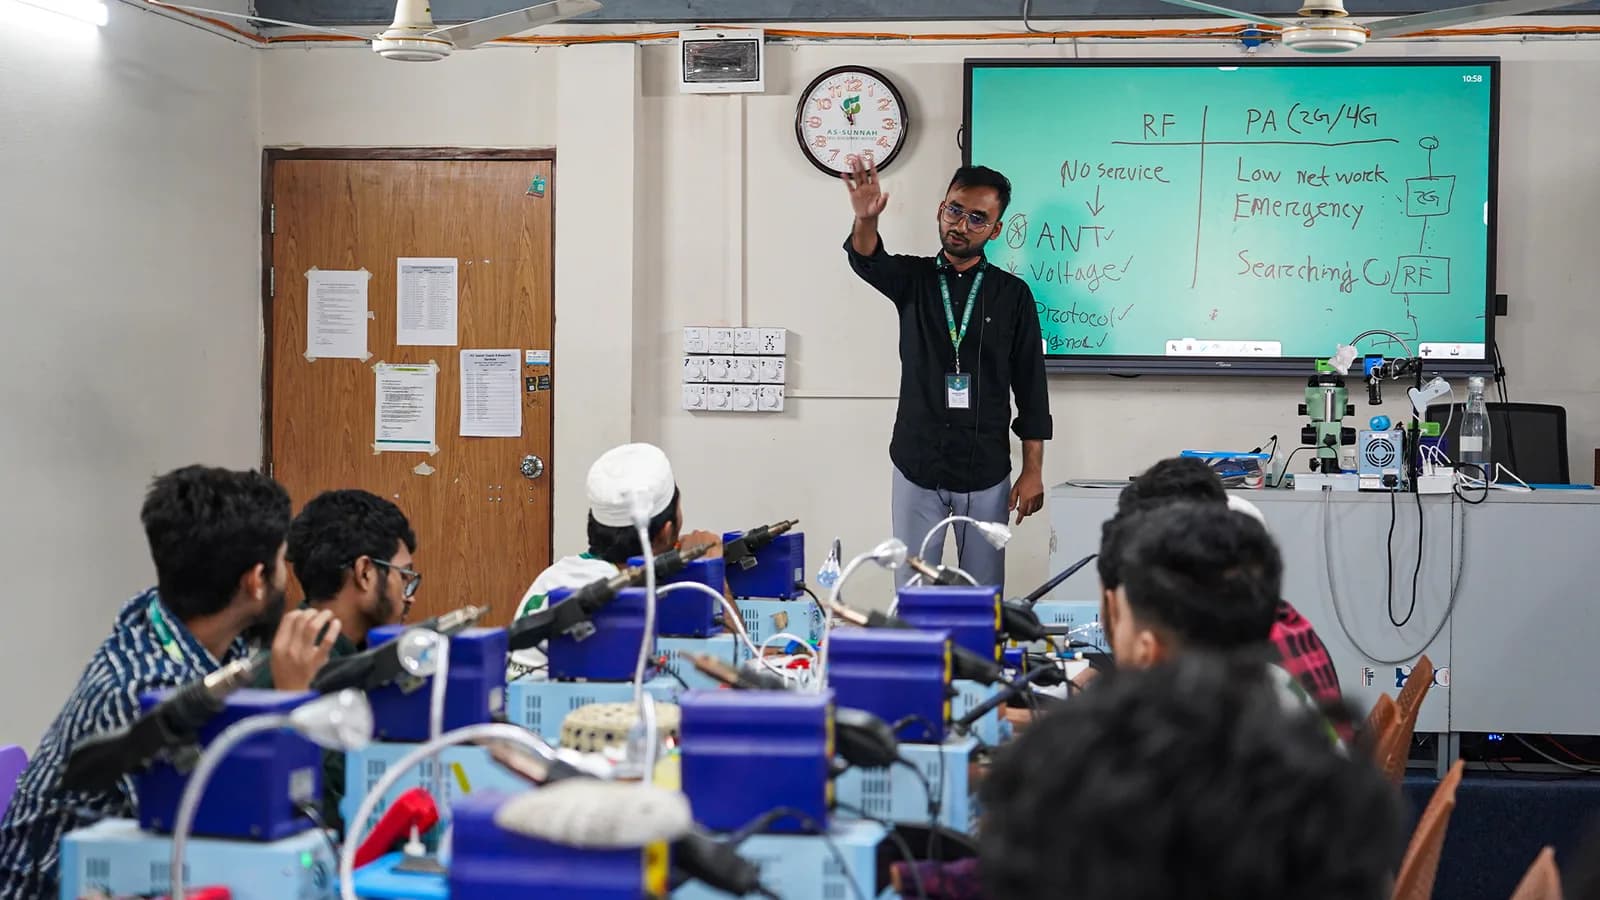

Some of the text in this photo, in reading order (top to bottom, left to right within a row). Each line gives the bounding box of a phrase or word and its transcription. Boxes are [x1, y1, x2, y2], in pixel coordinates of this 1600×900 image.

[1462, 74, 1483, 83] 10:58
[828, 85, 842, 98] 11
[844, 79, 862, 92] 12
[868, 85, 874, 97] 1
[816, 98, 832, 111] 10
[877, 98, 890, 111] 2
[809, 116, 822, 129] 9
[881, 118, 895, 130] 3
[1143, 113, 1176, 140] RF
[1246, 109, 1277, 134] PA
[815, 135, 827, 148] 8
[876, 135, 889, 149] 4
[829, 149, 840, 162] 7
[1097, 163, 1170, 183] service
[1236, 156, 1281, 183] Low
[1233, 193, 1364, 230] Emergency
[1036, 222, 1105, 252] ANT
[1030, 260, 1121, 293] Voltage
[1238, 250, 1360, 294] Searching
[1403, 265, 1433, 287] RF
